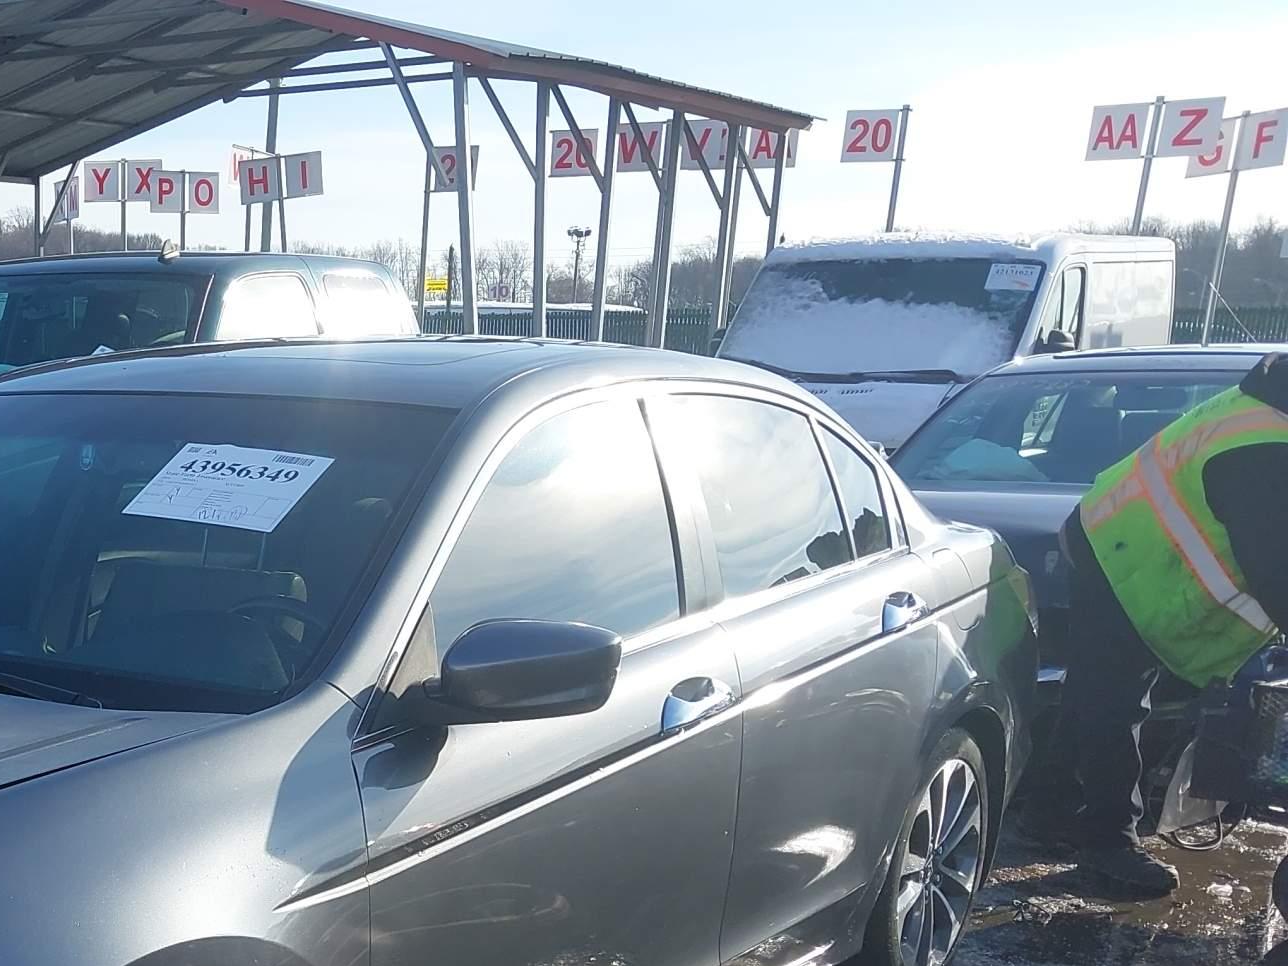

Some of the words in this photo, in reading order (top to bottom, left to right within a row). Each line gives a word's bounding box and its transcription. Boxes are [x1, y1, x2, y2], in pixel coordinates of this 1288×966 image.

[846, 118, 892, 153] 20
[1092, 113, 1138, 150] AA
[1172, 108, 1209, 147] Z
[1252, 119, 1279, 160] F
[554, 137, 594, 170] 20
[91, 167, 112, 195] Y
[134, 167, 154, 194] X
[248, 165, 270, 196] H
[300, 160, 308, 189] I
[158, 177, 175, 205] P
[194, 178, 214, 207] O
[180, 459, 300, 484] 43956349
